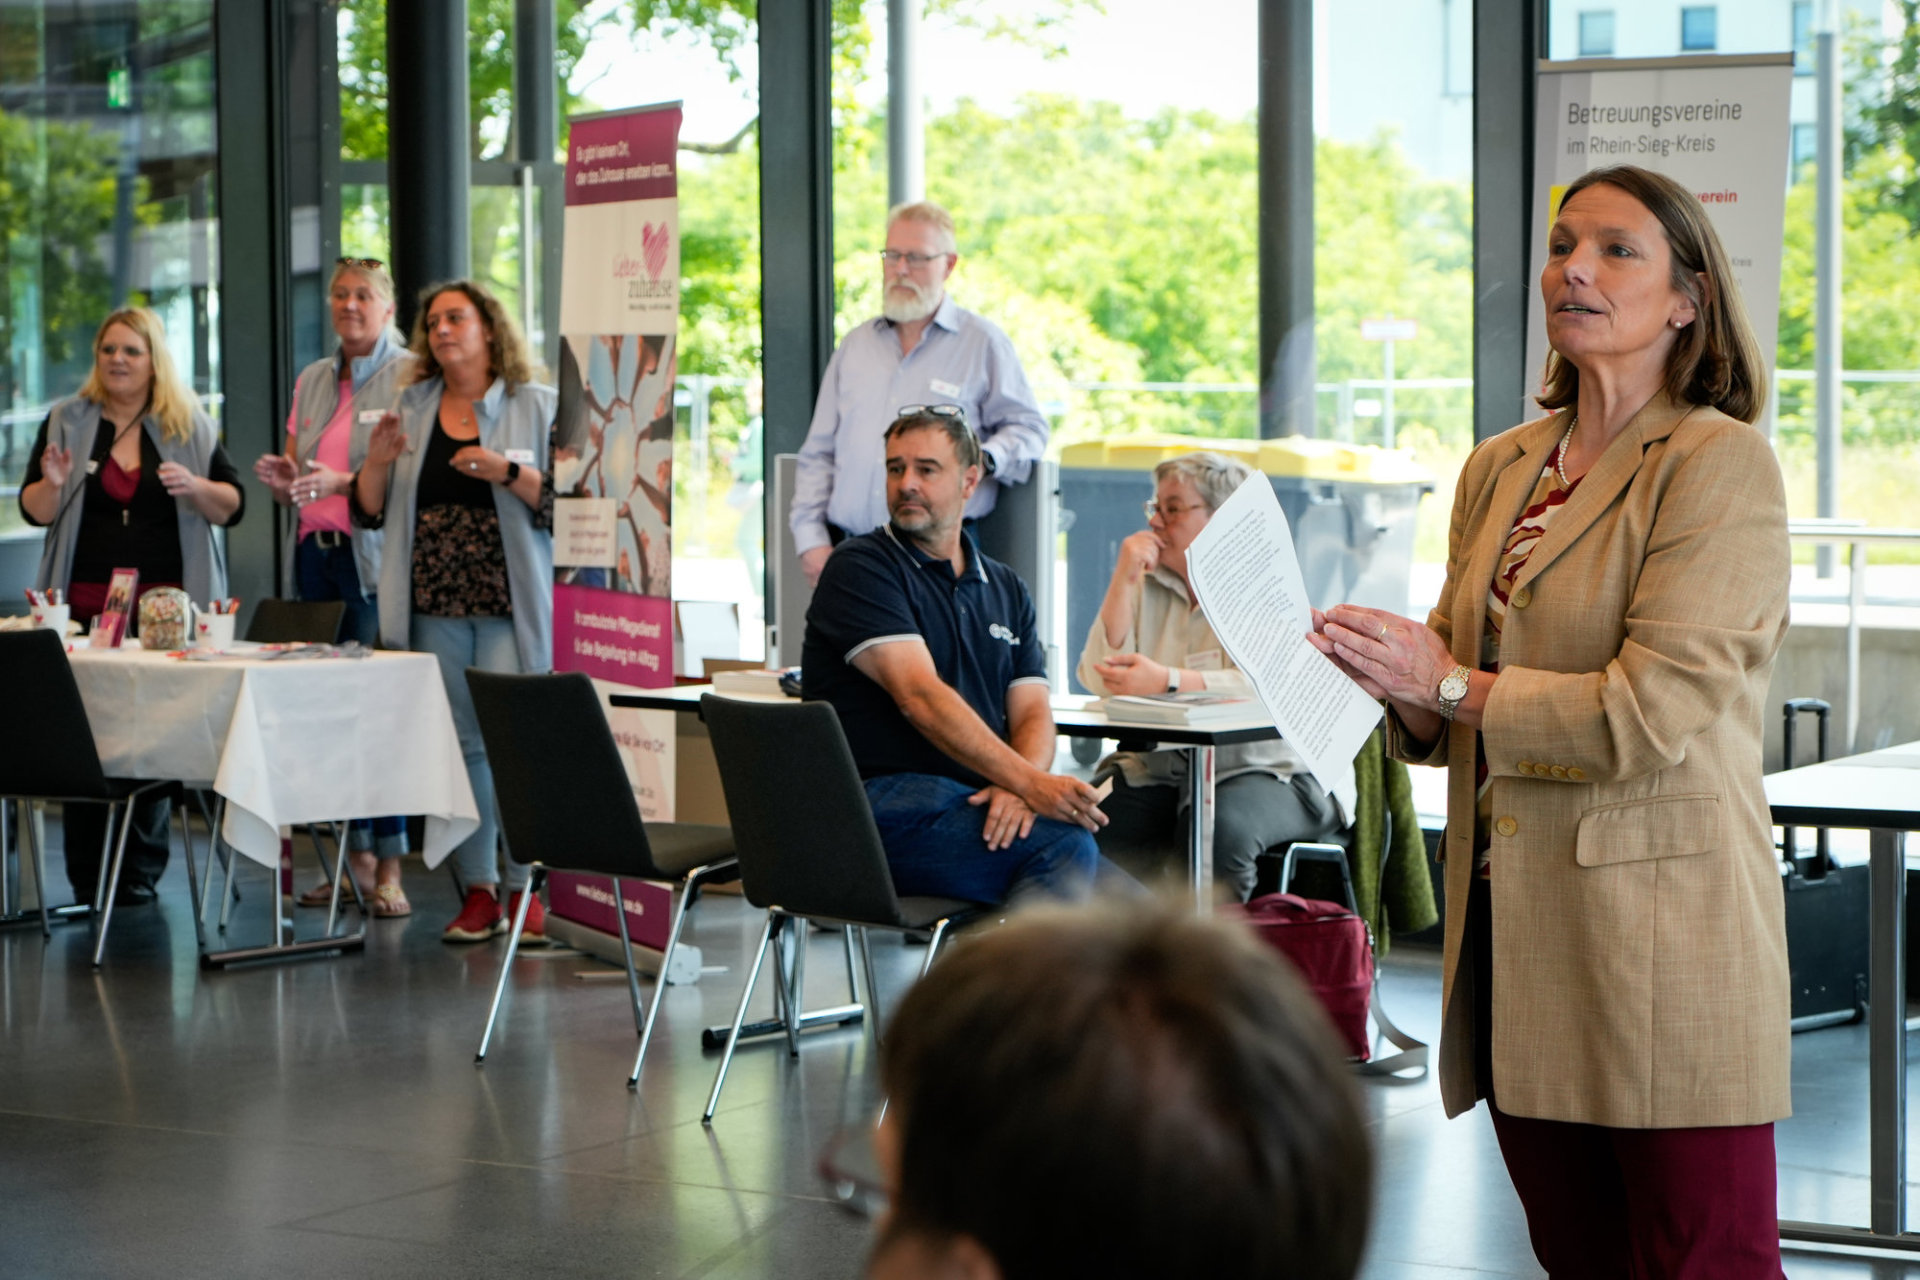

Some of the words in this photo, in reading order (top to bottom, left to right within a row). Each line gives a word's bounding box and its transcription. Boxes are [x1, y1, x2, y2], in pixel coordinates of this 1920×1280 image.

[1567, 99, 1742, 128] Betreuungsvereine
[1566, 137, 1585, 155] im
[1590, 134, 1716, 157] Rhein-Sieg-Kreis
